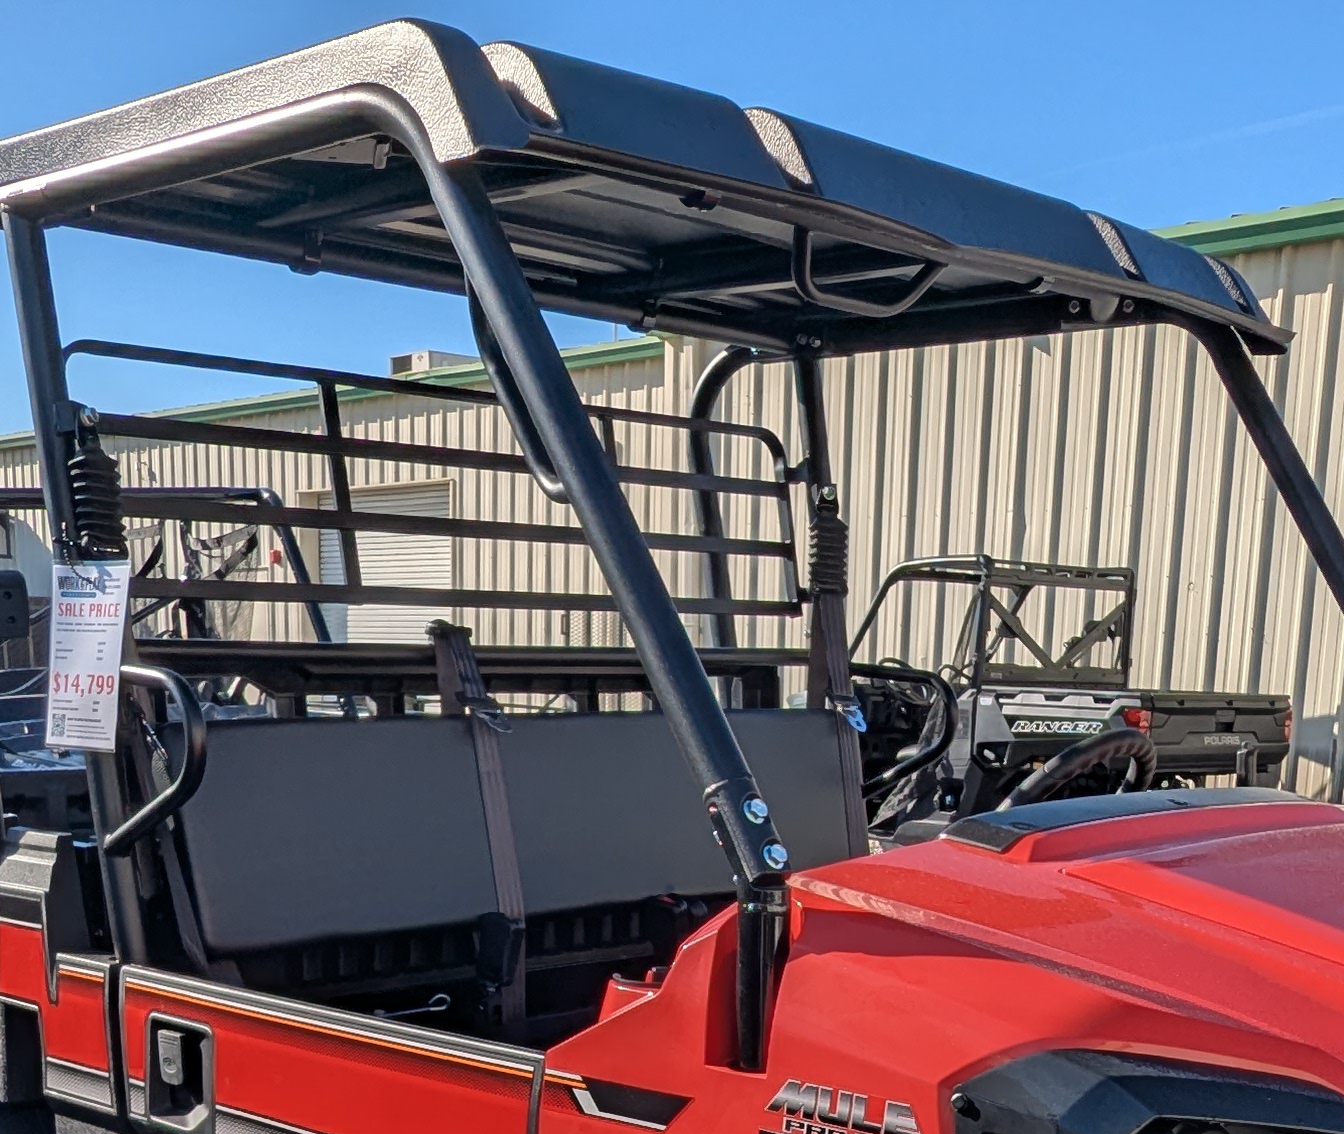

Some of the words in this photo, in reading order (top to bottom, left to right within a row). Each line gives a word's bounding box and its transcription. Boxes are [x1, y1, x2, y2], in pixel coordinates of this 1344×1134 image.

[57, 602, 85, 618] SALE
[88, 603, 121, 618] PRICE
[53, 671, 115, 697] $14,799
[1010, 720, 1103, 735] RANGER
[1203, 735, 1240, 746] POLARIS
